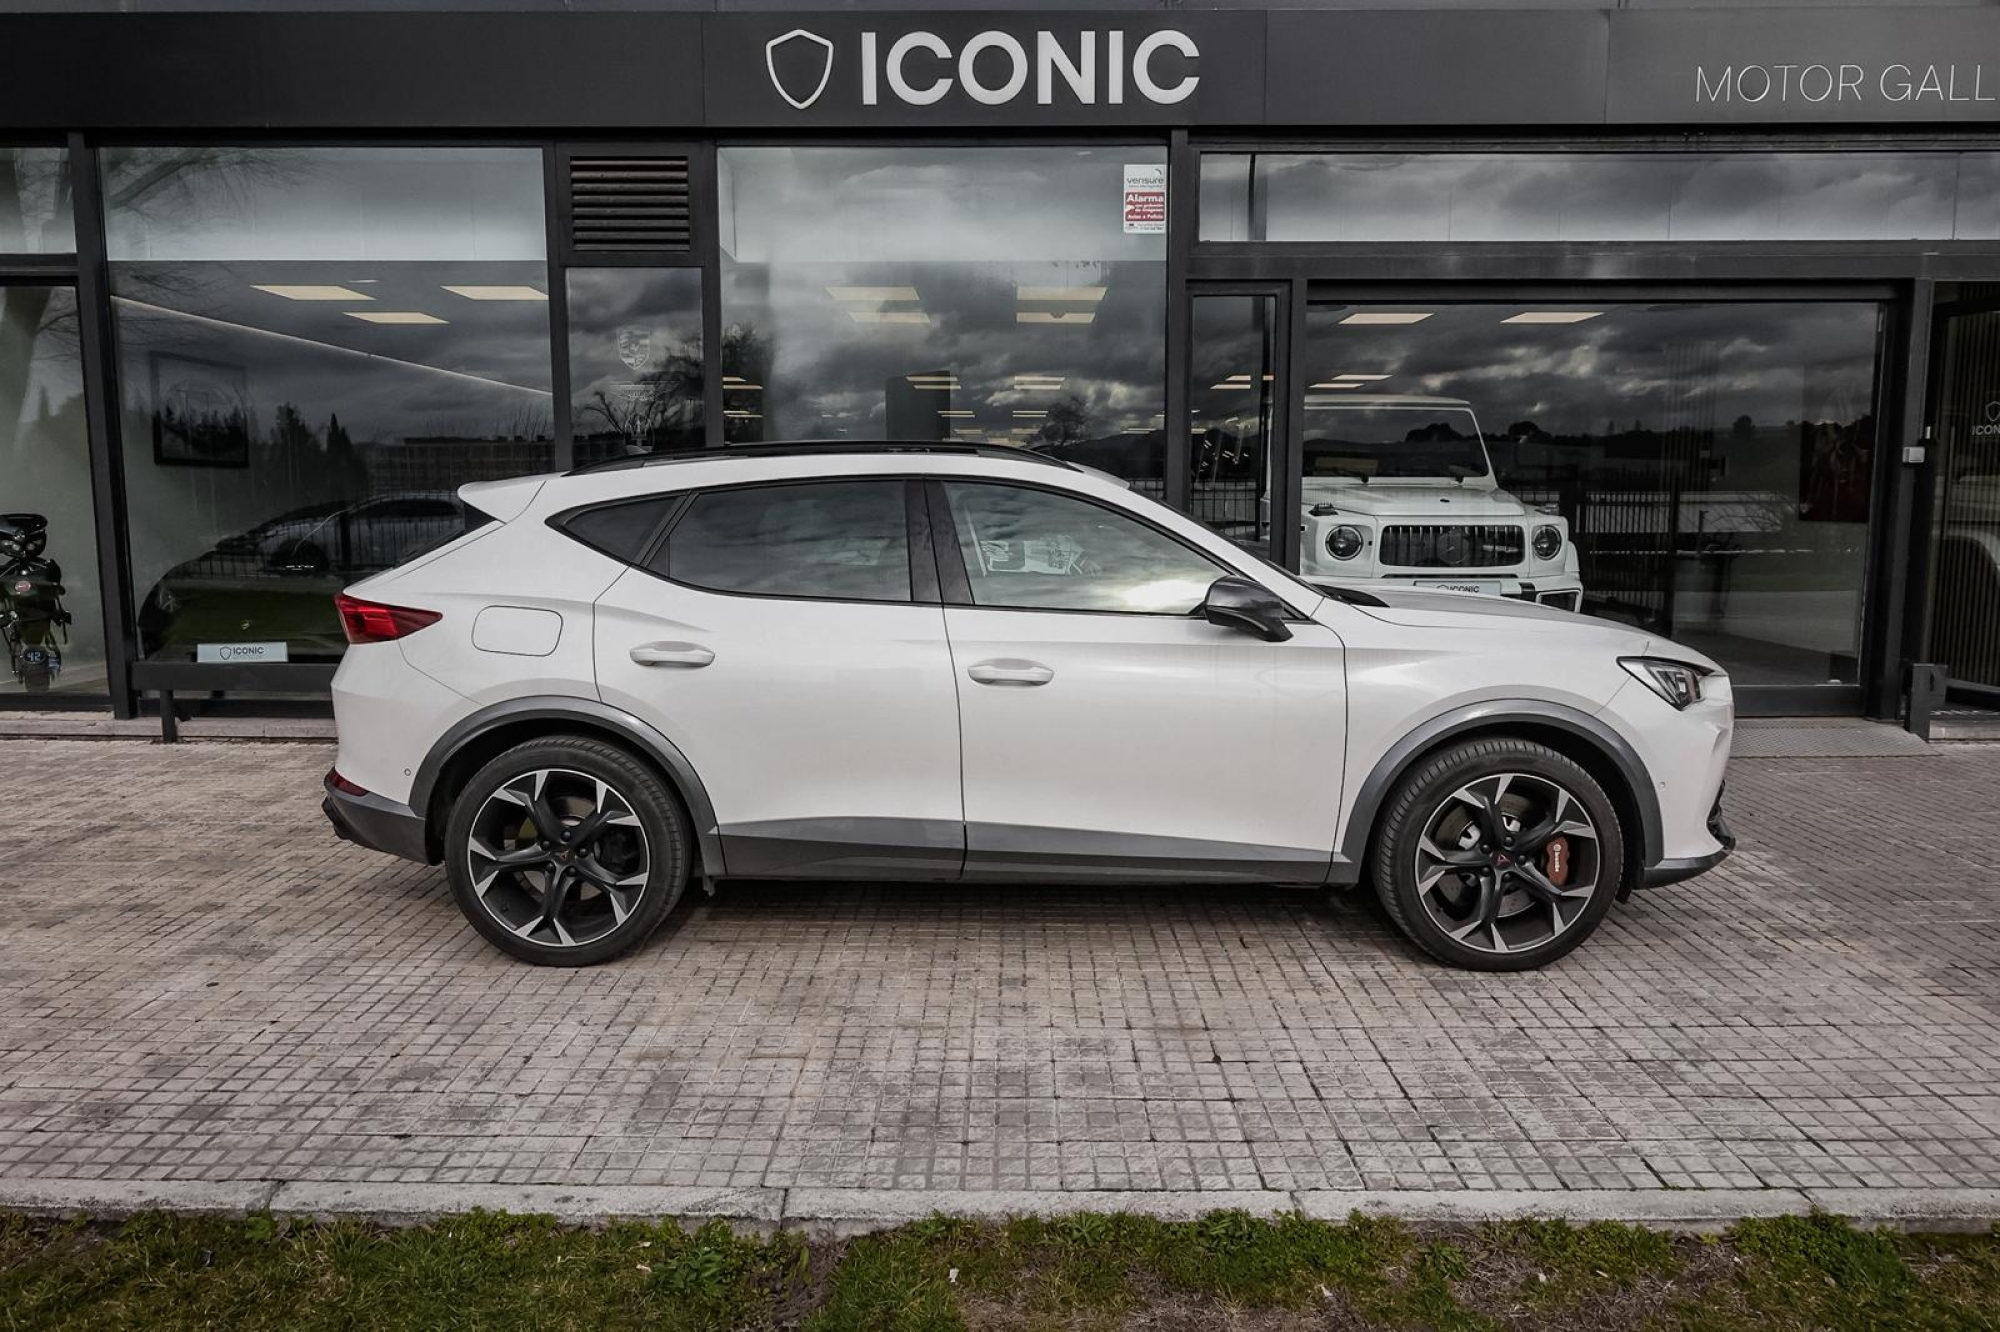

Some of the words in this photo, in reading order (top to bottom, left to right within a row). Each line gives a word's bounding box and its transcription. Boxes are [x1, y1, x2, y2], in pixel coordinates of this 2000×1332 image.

[861, 29, 1200, 106] ICONIC
[1695, 64, 1865, 102] MOTOR
[1879, 64, 1996, 102] GALL
[1126, 193, 1164, 202] Alarma
[233, 646, 264, 655] ICONIC
